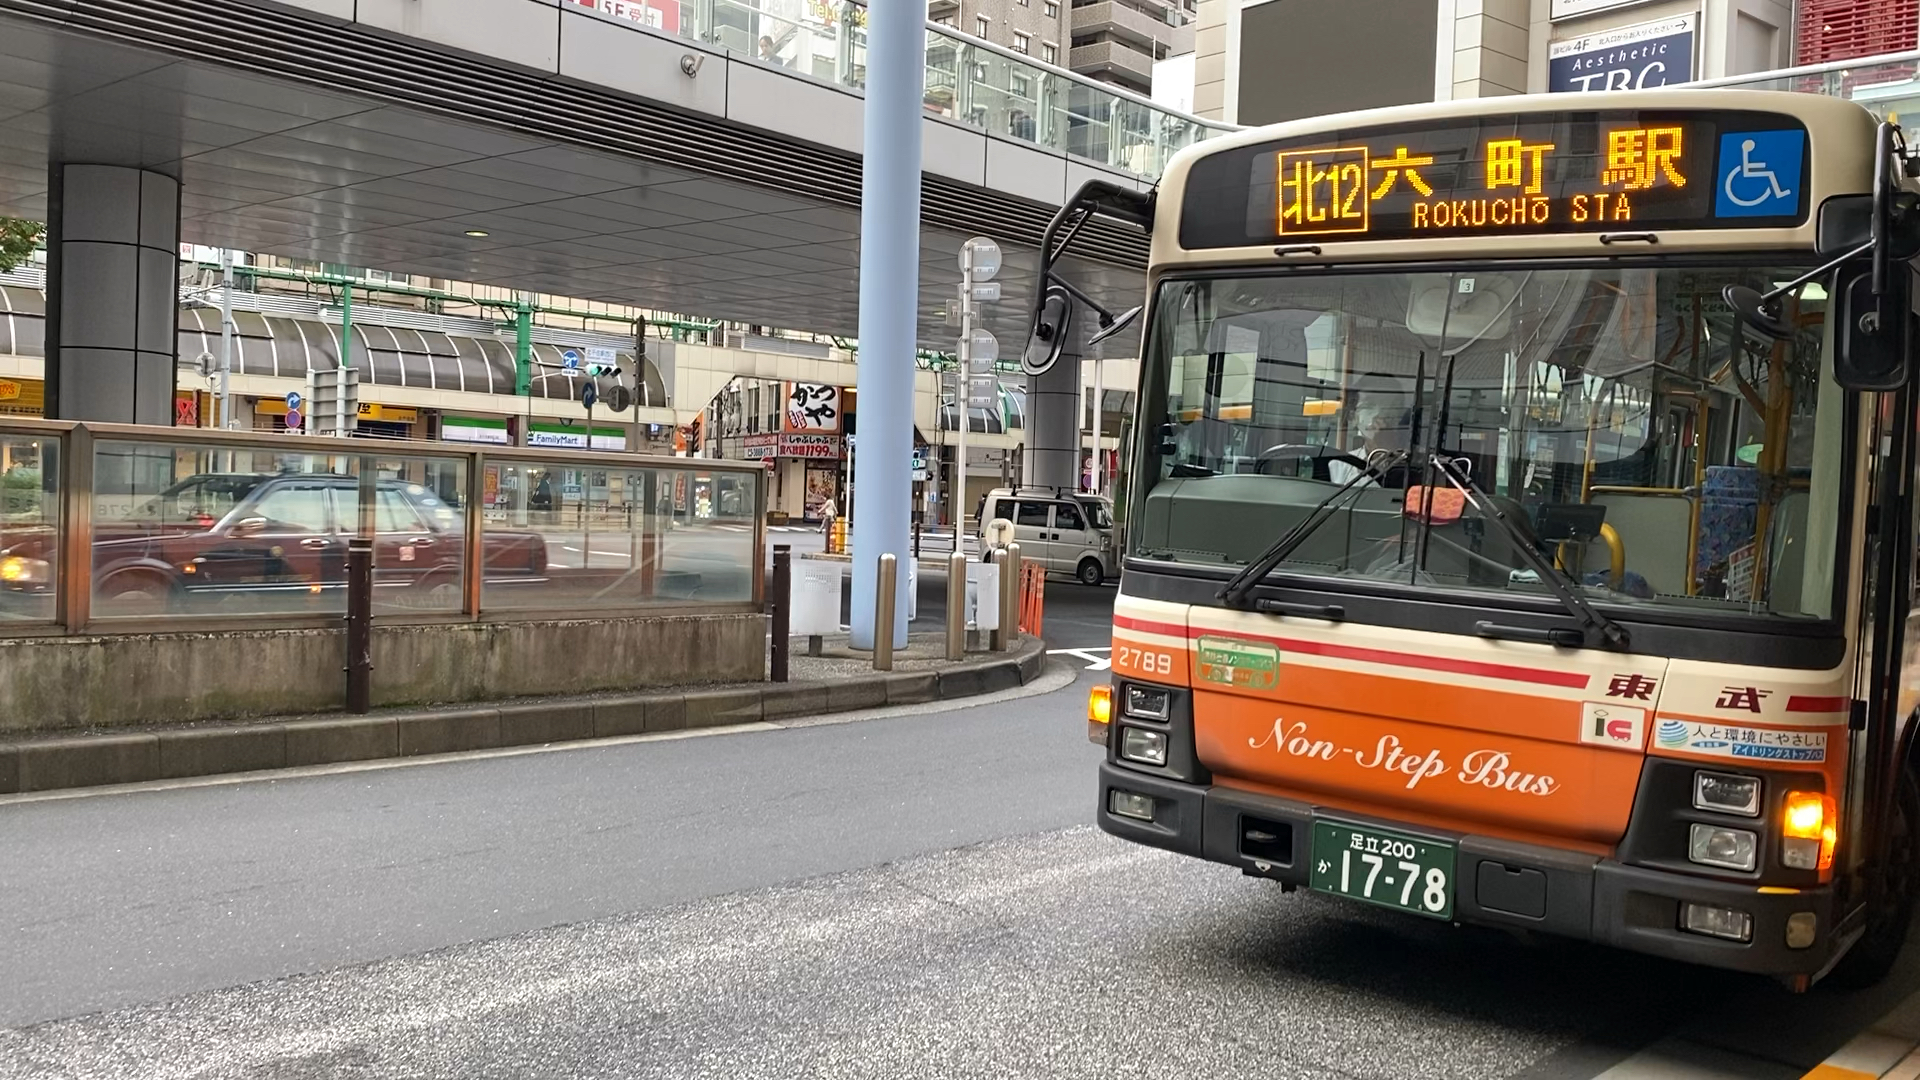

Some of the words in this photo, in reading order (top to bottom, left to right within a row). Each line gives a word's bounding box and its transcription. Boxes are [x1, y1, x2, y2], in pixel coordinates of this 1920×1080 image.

[1572, 43, 1668, 71] Aesthetic
[1573, 38, 1590, 52] 4F
[1570, 61, 1666, 92] TBC
[1283, 160, 1361, 225] 北12
[1572, 193, 1631, 221] STA
[536, 434, 578, 444] FamilyMart
[1119, 646, 1171, 675] 2789
[1693, 725, 1825, 746] 人と環境にやさしい
[1248, 717, 1451, 789] Non-Step
[1458, 749, 1561, 795] Bus
[1733, 744, 1823, 759] アイドリングストップバス
[1317, 858, 1332, 874] か
[1341, 850, 1446, 912] 17-78
